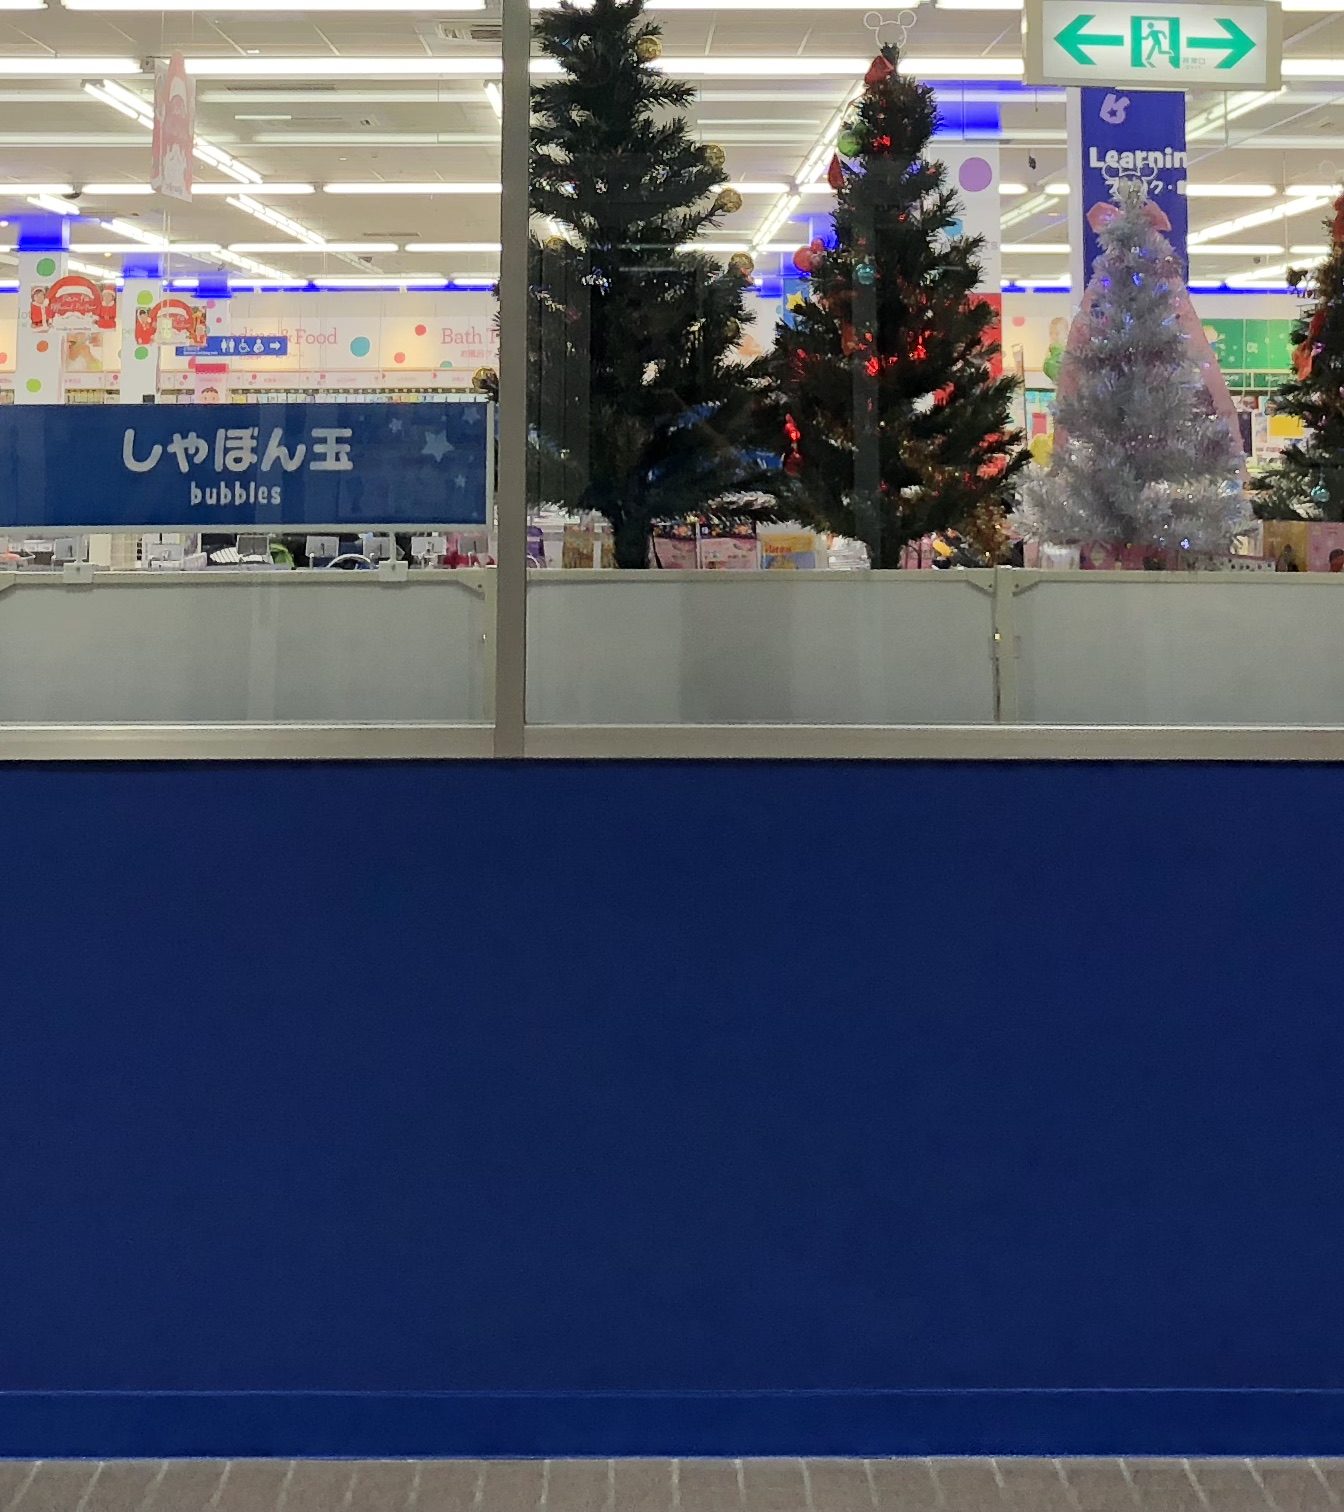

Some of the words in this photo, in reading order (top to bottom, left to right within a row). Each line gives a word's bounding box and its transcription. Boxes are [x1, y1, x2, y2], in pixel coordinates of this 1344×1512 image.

[294, 327, 338, 345] Food
[441, 326, 483, 345] Bath
[122, 427, 354, 474] しゃぼん玉
[190, 481, 282, 506] bubbles
